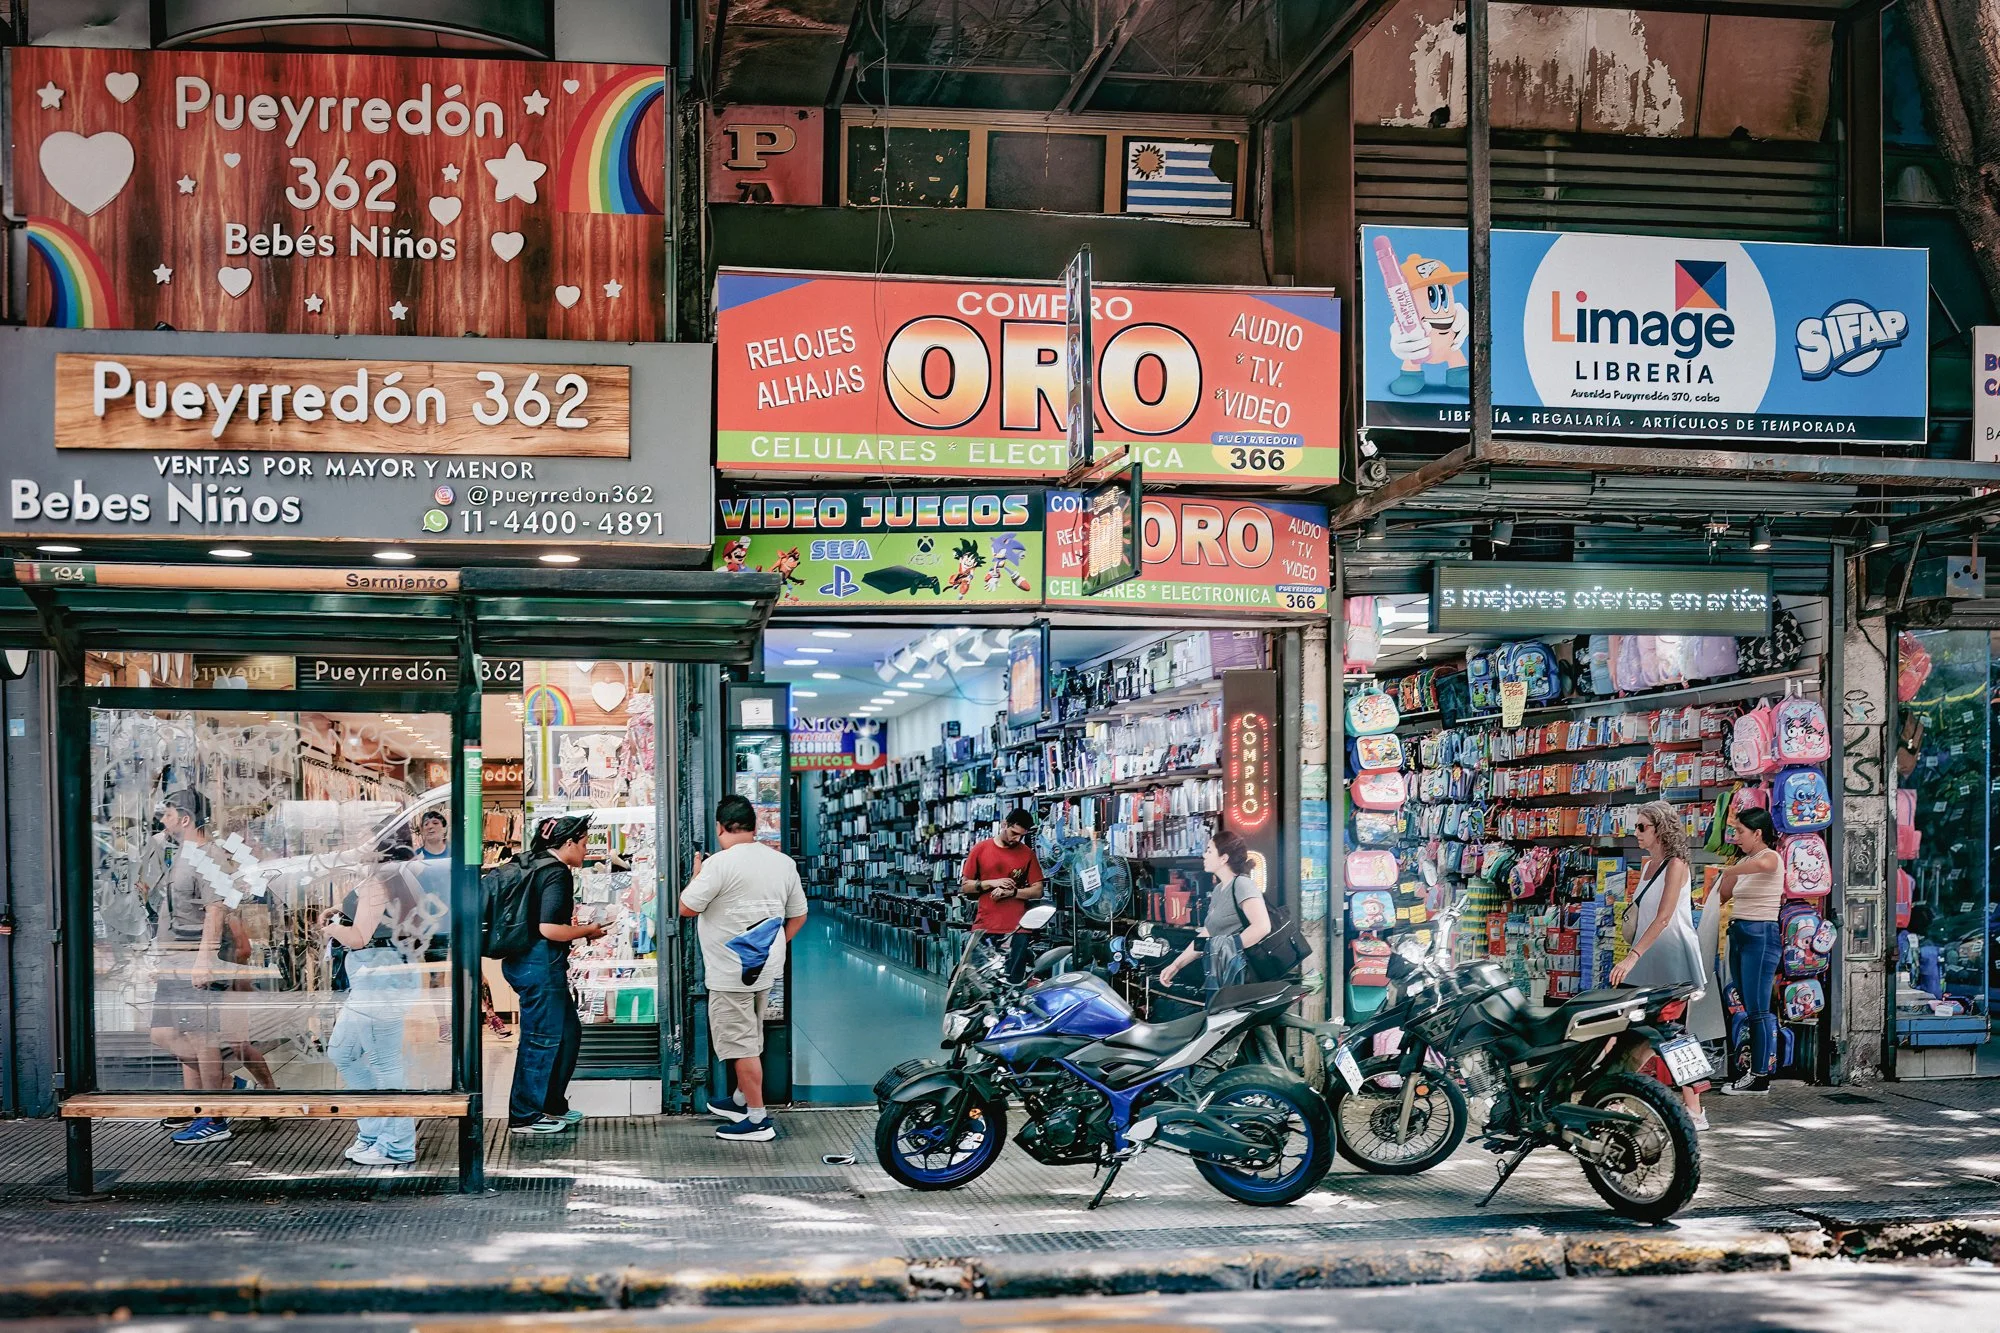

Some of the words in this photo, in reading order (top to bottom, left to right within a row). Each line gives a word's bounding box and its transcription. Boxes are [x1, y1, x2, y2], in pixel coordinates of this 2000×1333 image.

[175, 76, 504, 148] Pueyrredón
[285, 157, 397, 213] 362
[225, 223, 336, 259] Bebés
[350, 224, 457, 261] Niños
[1230, 312, 1304, 352] AUDIO
[1552, 290, 1735, 359] Limage
[746, 325, 857, 370] RELOJES
[1796, 309, 1908, 376] SIFAP
[883, 315, 1203, 437] ORO
[1250, 355, 1285, 389] T.V.
[1576, 359, 1714, 384] LIBRERÍA
[94, 361, 447, 438] Pueyrredón
[472, 370, 589, 430] 362
[756, 364, 866, 410] ALHAJAS
[1570, 388, 1611, 399] Avenida
[1532, 411, 1622, 427] REGALARÍA
[1642, 414, 1728, 430] ARTÍCULOS
[1736, 419, 1755, 431] DE
[1761, 420, 1857, 433] TEMPORADA
[751, 436, 937, 462] CELULARES
[1218, 434, 1297, 446] PUEYRREDON
[153, 455, 251, 477] VENTAS
[263, 457, 313, 477] POR
[325, 457, 416, 479] MAYOR
[423, 460, 440, 478] Y
[446, 460, 535, 480] MENOR
[1230, 447, 1285, 471] 366
[11, 479, 151, 522] Bebes
[167, 482, 302, 524] Niños
[467, 485, 655, 508] @pueyrredon362
[719, 496, 848, 530] VIDEO
[861, 494, 1029, 528] JUEGOS
[1141, 500, 1274, 569] ORO
[1288, 518, 1321, 540] AUDIO
[810, 539, 873, 561] SEGA
[1297, 541, 1313, 559] T.V.
[346, 573, 448, 591] Sarmiento
[1161, 585, 1271, 604] ELECTRONICA
[1286, 594, 1316, 609] 366
[1463, 585, 1566, 612] mejores
[1574, 586, 1664, 609] ofertas
[1668, 592, 1701, 610] en
[316, 660, 447, 687] Pueyrredón
[481, 661, 521, 681] 362
[1241, 712, 1259, 814] COMPRO
